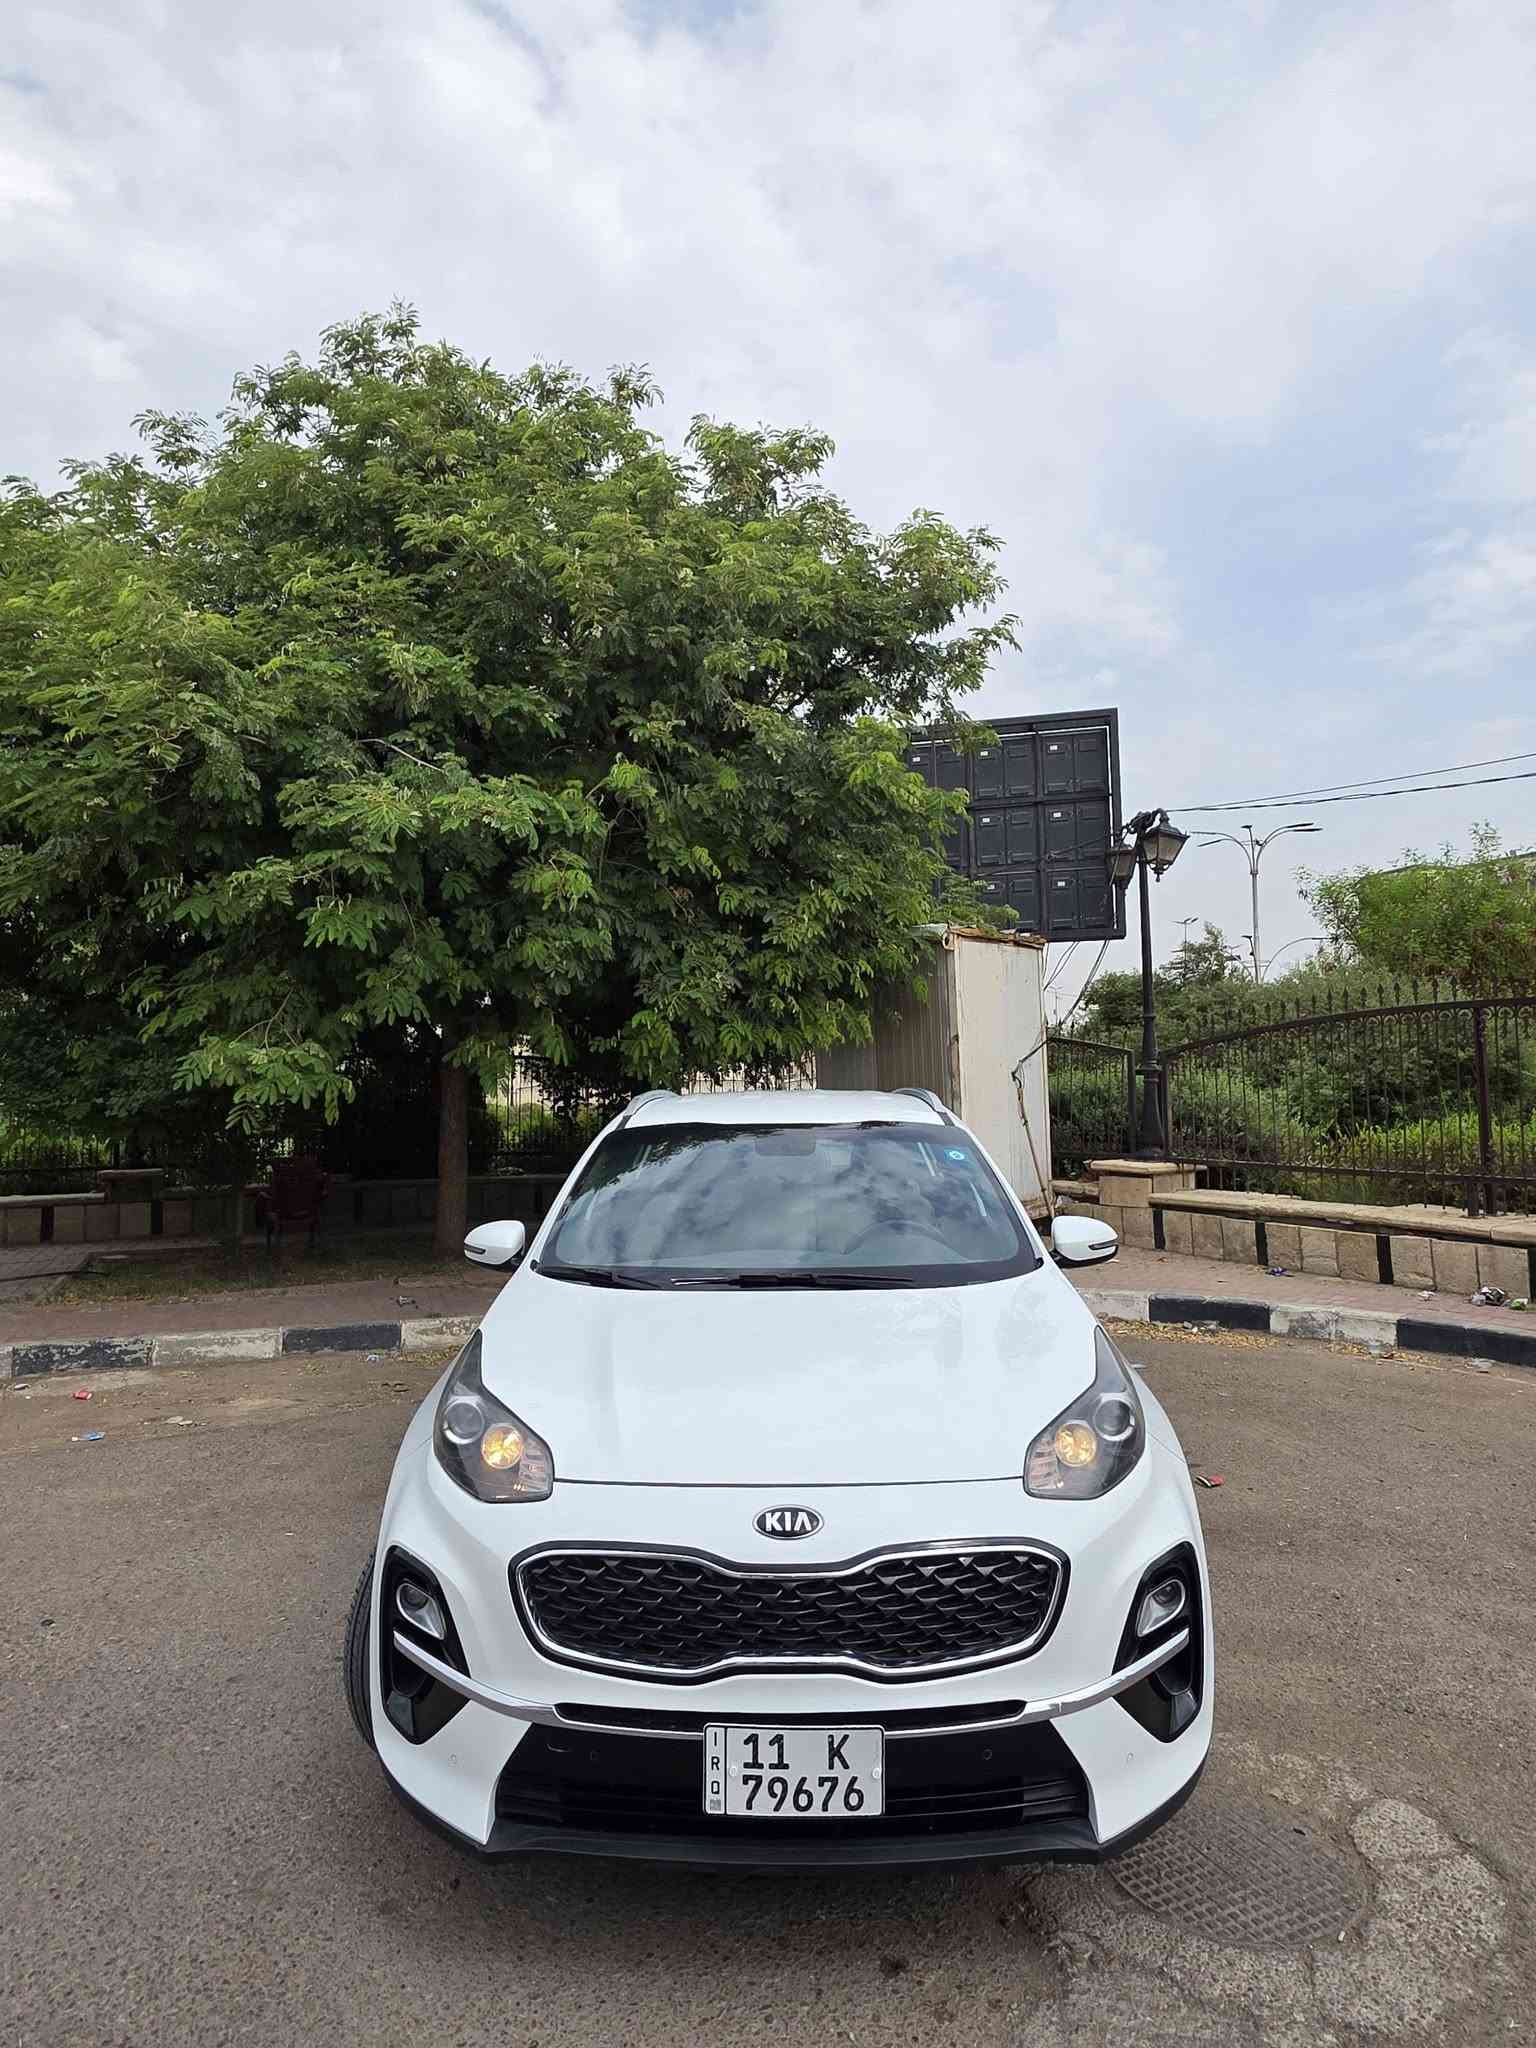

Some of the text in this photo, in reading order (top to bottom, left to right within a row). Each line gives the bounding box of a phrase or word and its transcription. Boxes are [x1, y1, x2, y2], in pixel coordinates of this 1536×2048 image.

[765, 1511, 812, 1531] KIA
[743, 1733, 850, 1770] 11 K
[742, 1774, 864, 1812] 79676
